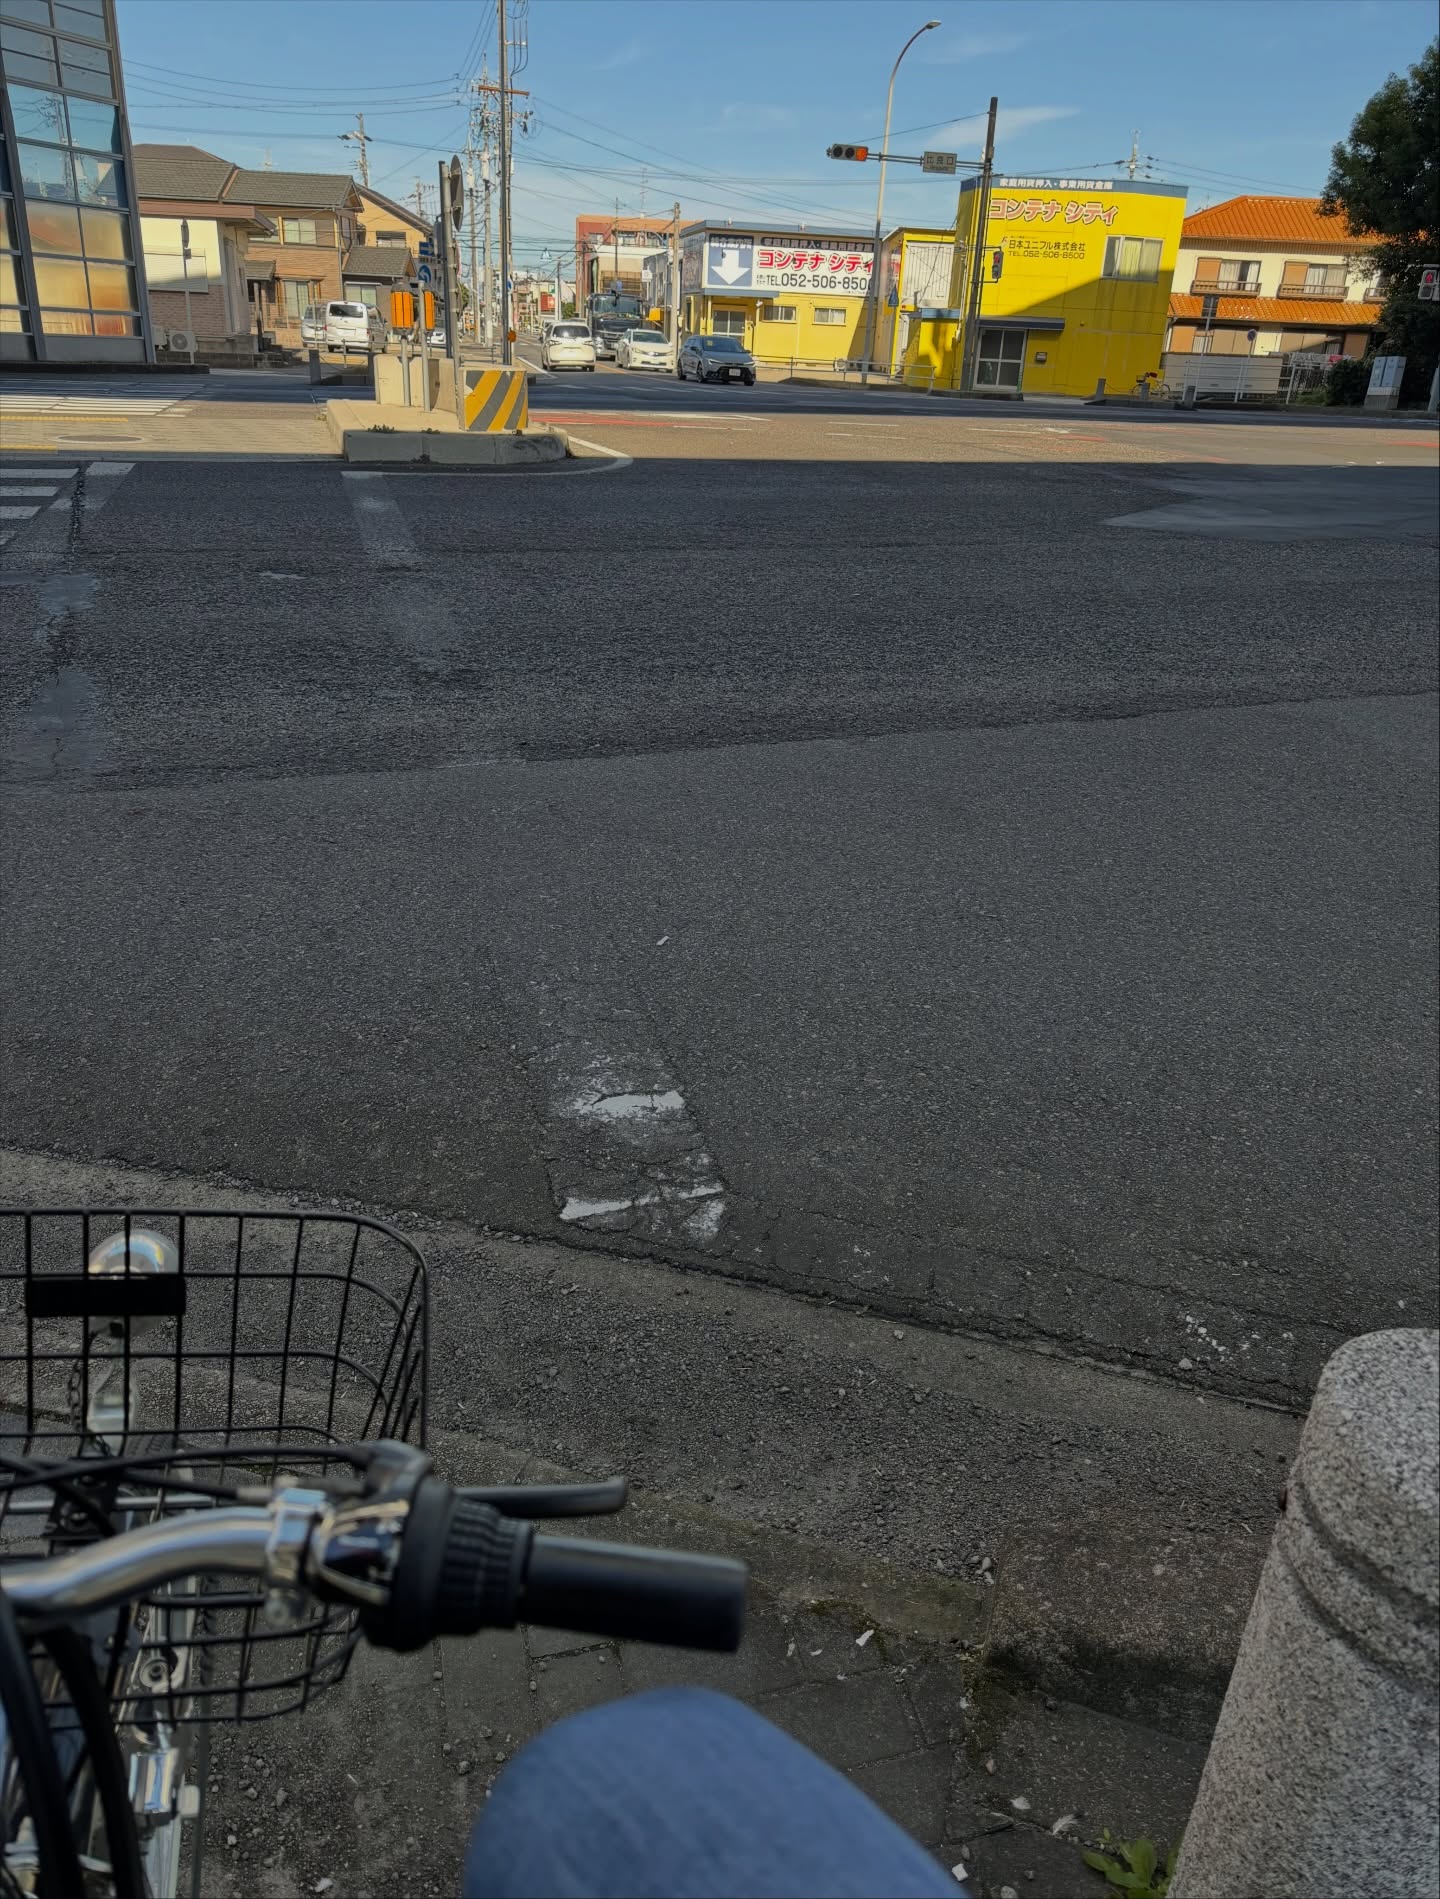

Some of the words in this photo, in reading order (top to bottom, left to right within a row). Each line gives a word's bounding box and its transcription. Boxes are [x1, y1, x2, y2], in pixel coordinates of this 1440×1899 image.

[989, 198, 1062, 222] コンテナ
[1065, 201, 1119, 226] シティ
[758, 250, 826, 272] コンテナ
[829, 254, 873, 275] シティ
